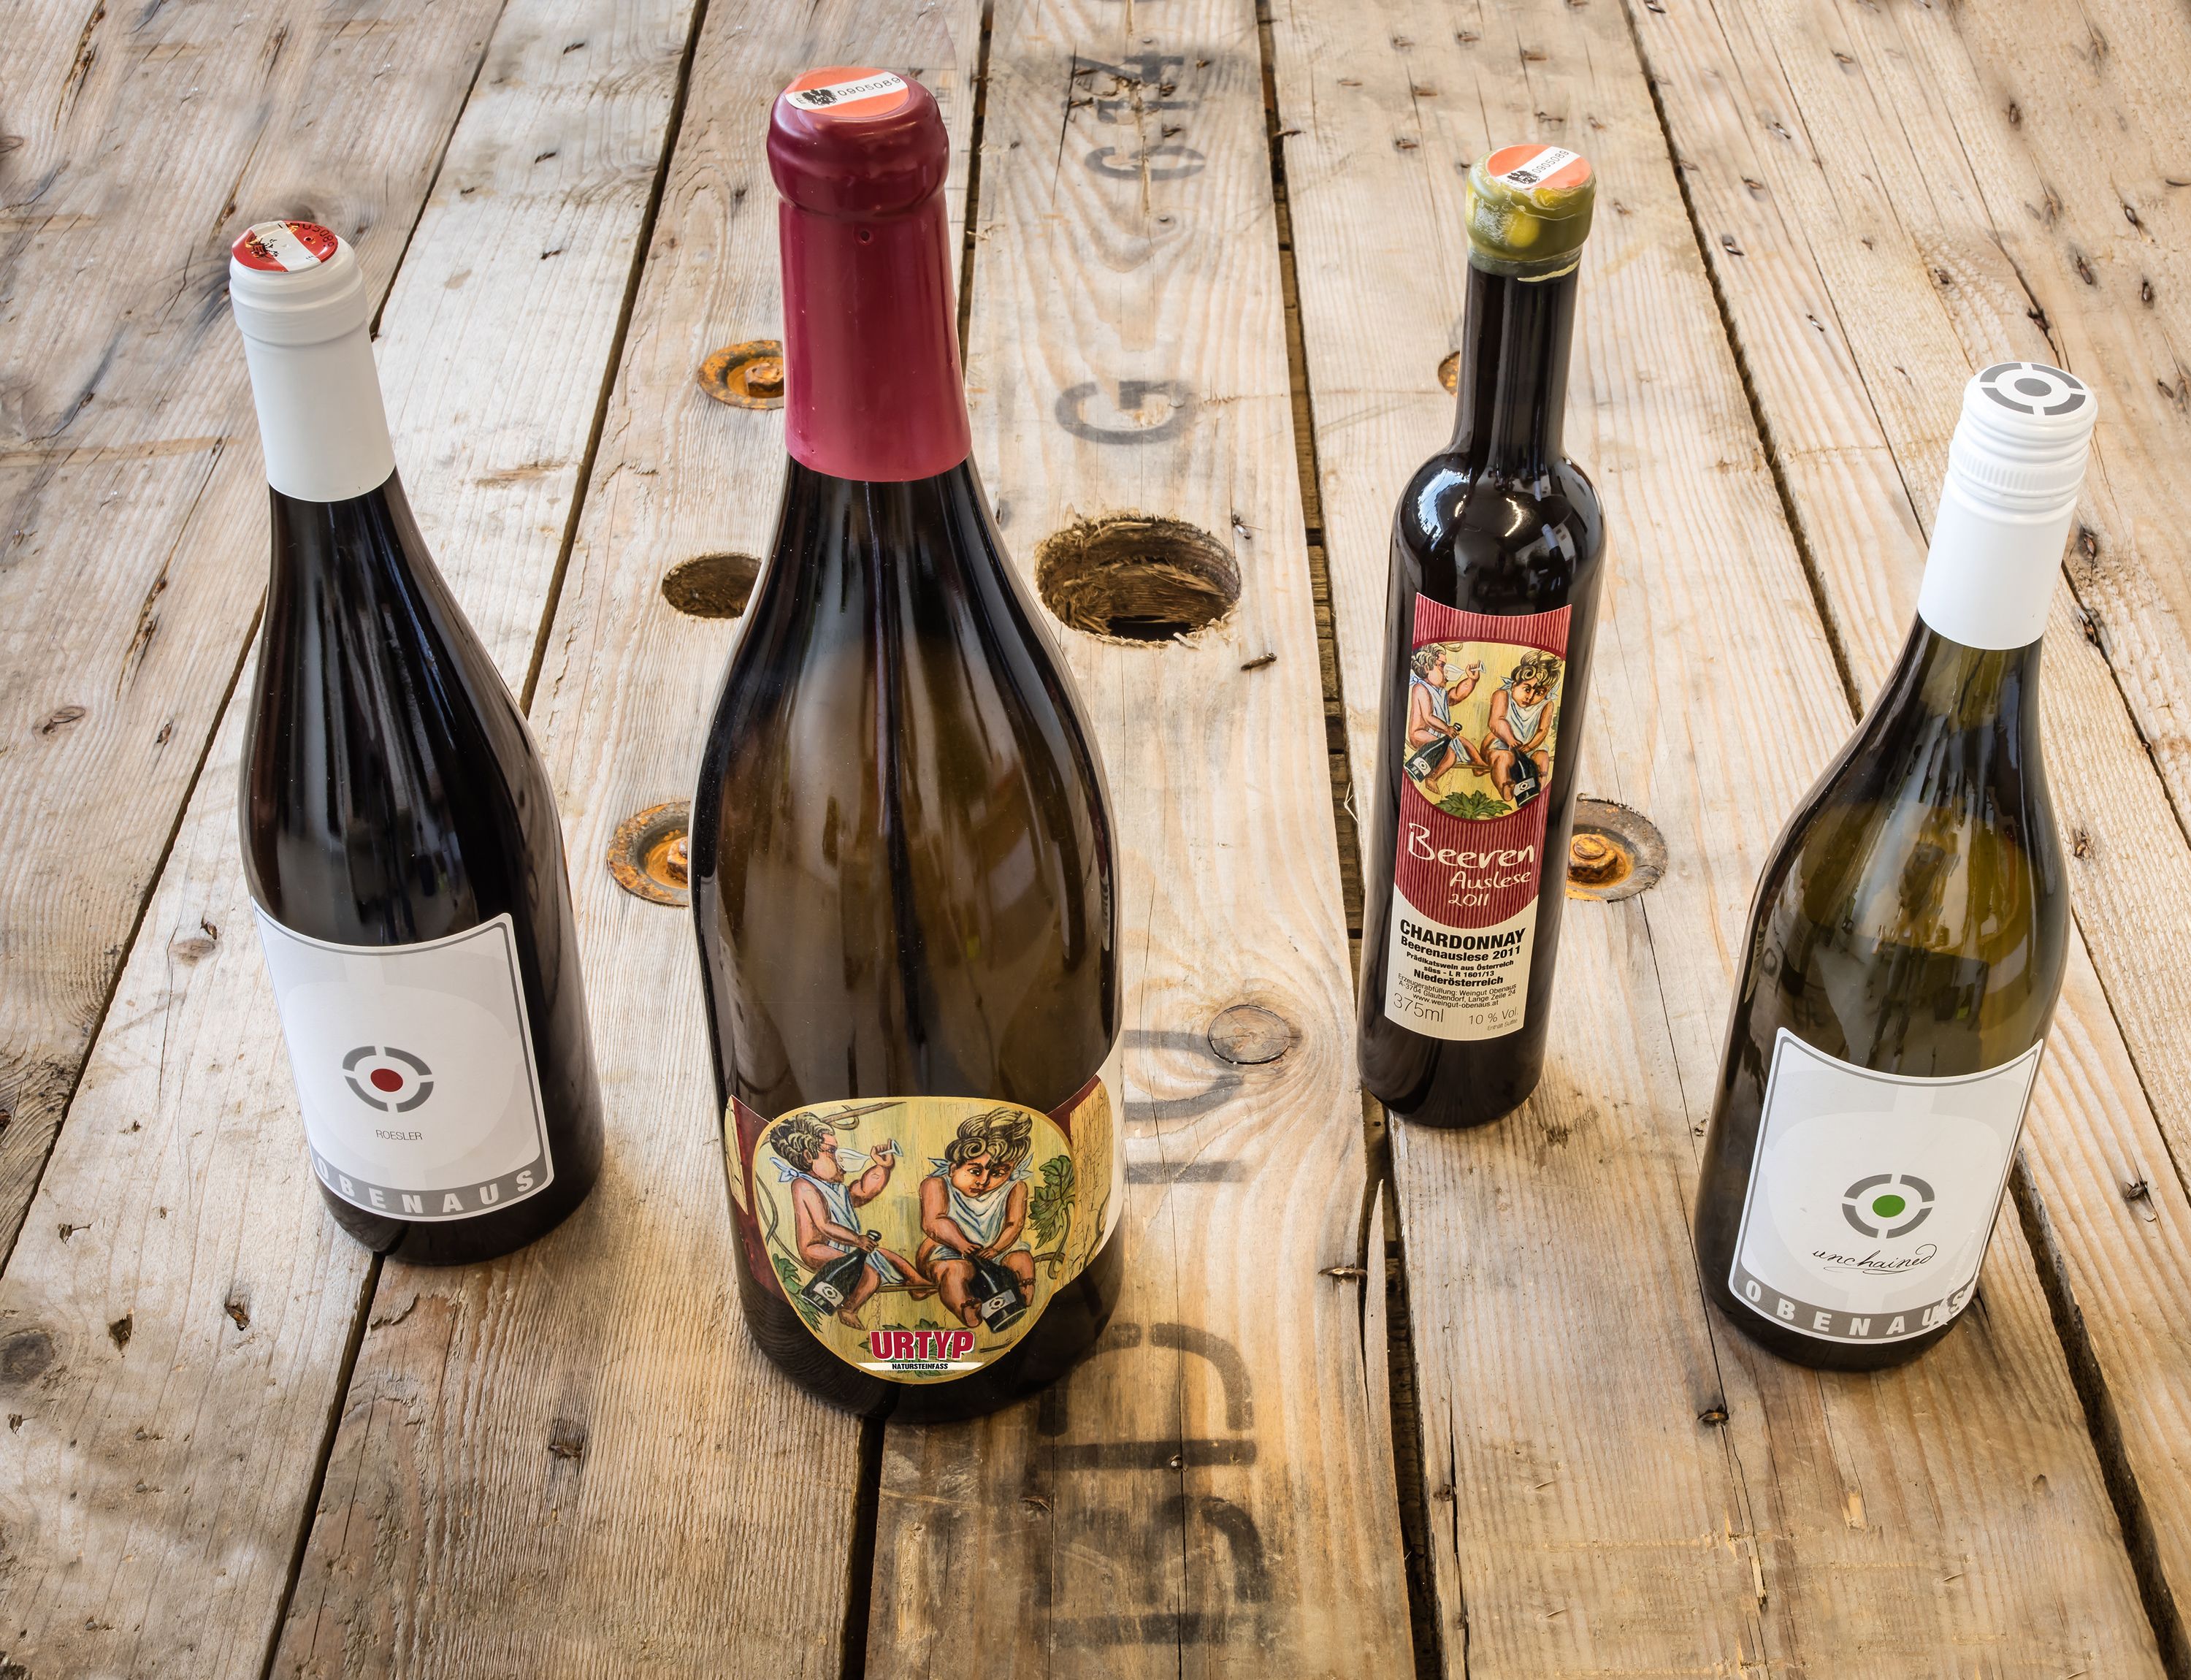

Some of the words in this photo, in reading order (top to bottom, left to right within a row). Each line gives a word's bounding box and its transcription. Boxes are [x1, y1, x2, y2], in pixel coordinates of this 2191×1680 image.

[1532, 150, 1569, 174] 0905089
[1055, 379, 1196, 445] G
[1408, 822, 1534, 869] Beeren
[1450, 871, 1532, 890] Auslese
[1448, 893, 1489, 907] 2011
[1400, 919, 1526, 950] CHARDONNAY
[1401, 935, 1488, 962] Beerenauslese
[1492, 944, 1521, 961] 2011
[1406, 951, 1458, 970] Prädikatswein
[1477, 960, 1514, 971] Österreich
[1413, 969, 1504, 987] Niederösterreich
[1423, 966, 1441, 974] süss
[1398, 973, 1458, 996] Erzeugerabfüllung:
[1459, 988, 1487, 998] Weingut
[1488, 983, 1517, 994] Obenaus
[1399, 980, 1421, 994] A-3704
[1423, 990, 1467, 1004] Glaubendorf,
[1468, 996, 1489, 1005] Lange
[1491, 991, 1507, 1001] Zeile
[1508, 989, 1516, 997] 24
[1393, 993, 1444, 1023] 375ml
[1412, 993, 1499, 1009] www.weingut-obenaus.at
[1469, 1014, 1483, 1025] 10
[1488, 1012, 1498, 1023] %
[1502, 1006, 1519, 1020] Vol.
[375, 1129, 423, 1141] ROESLER
[316, 1156, 534, 1214] OBENAUS
[1812, 1243, 1938, 1275] unchained
[870, 1331, 975, 1361] URTYP
